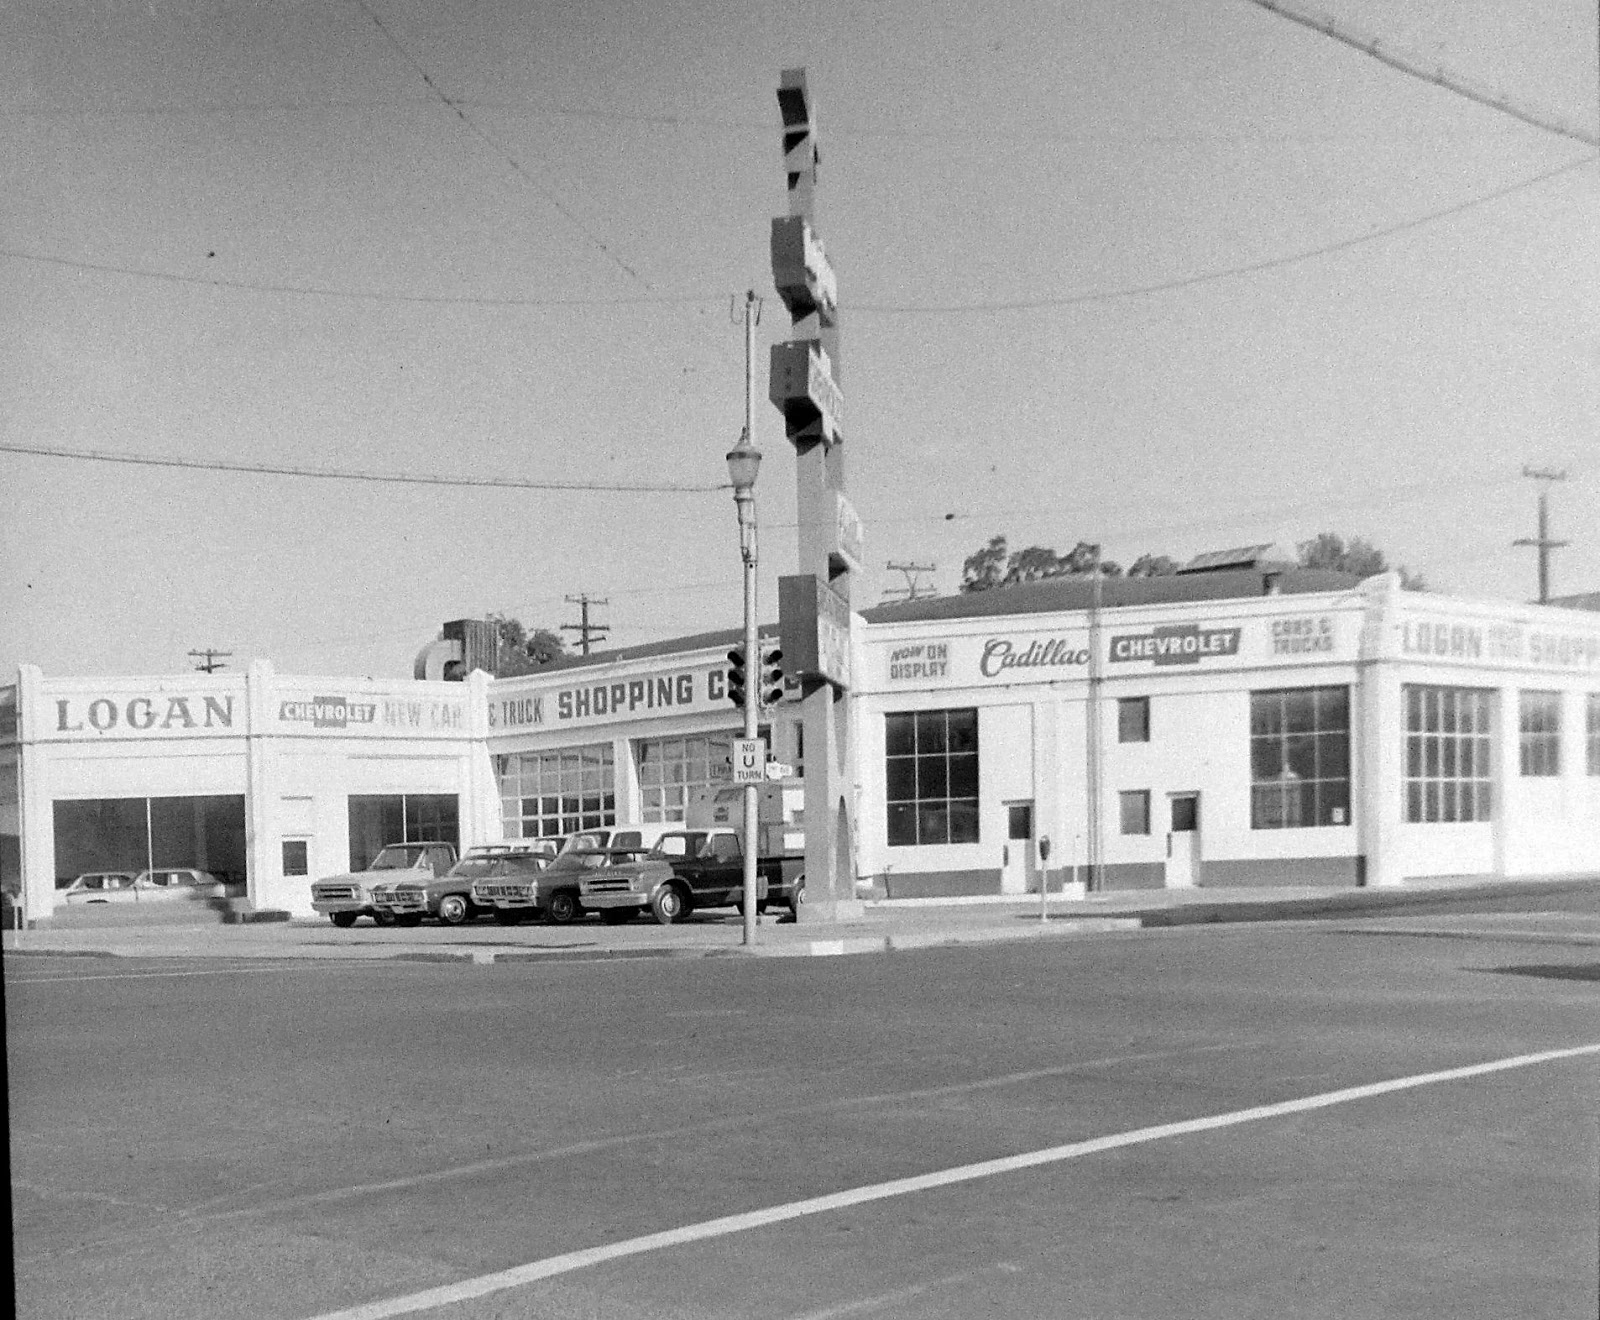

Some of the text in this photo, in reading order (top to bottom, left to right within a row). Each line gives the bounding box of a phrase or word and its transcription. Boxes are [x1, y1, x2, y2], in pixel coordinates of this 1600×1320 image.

[1116, 634, 1235, 658] CHEVROLET
[1402, 621, 1482, 658] LOGAN
[927, 643, 947, 660] ON
[980, 638, 1092, 678] Cadillac
[890, 661, 947, 680] DISPLAY
[384, 700, 421, 728] NEW
[430, 703, 463, 729] CAR
[502, 697, 543, 726] TRUCK
[558, 673, 692, 720] SHOPPING
[56, 695, 235, 731] LOGAN
[284, 704, 371, 721] CHEVROLET
[742, 743, 755, 752] NO
[743, 755, 755, 768] U
[737, 770, 762, 780] TURN
